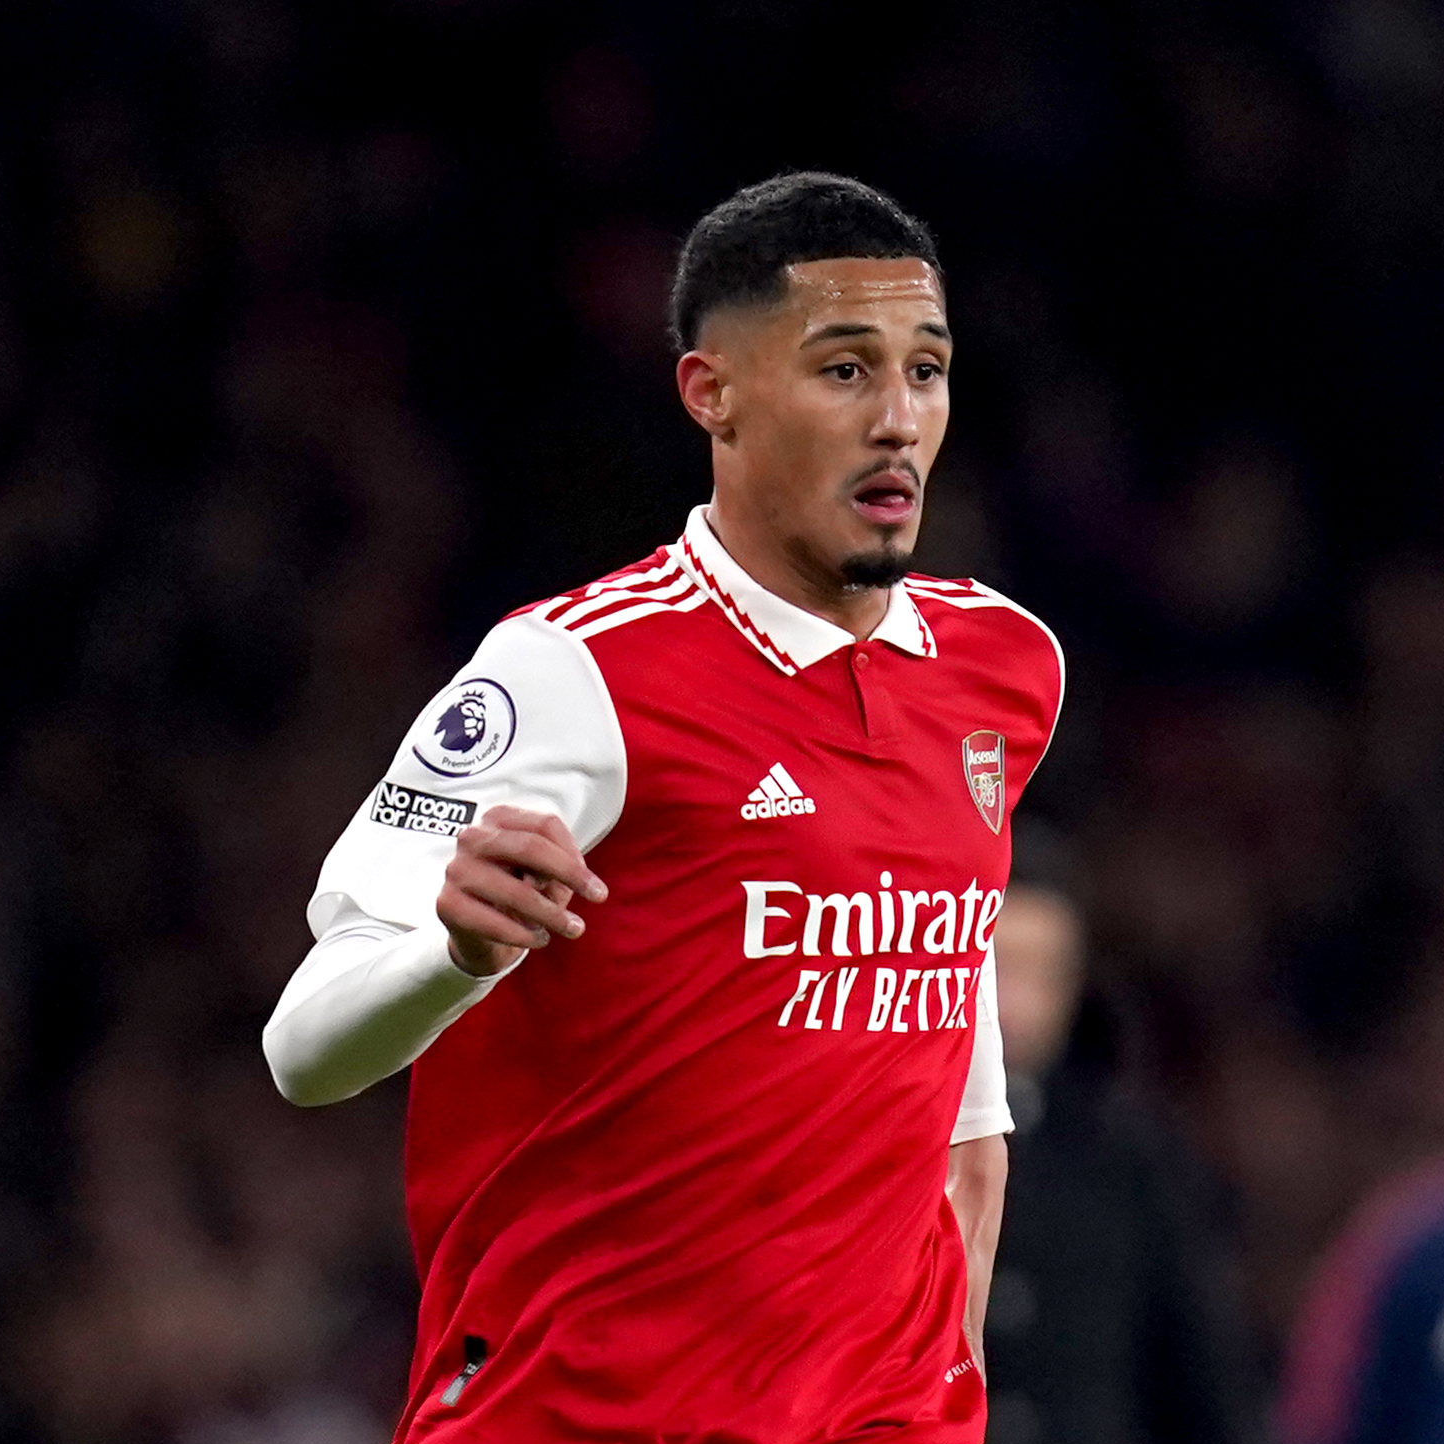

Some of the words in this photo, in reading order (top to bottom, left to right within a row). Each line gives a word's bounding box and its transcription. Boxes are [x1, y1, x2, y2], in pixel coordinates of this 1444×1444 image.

[442, 756, 476, 768] Premier
[476, 733, 500, 762] League
[969, 746, 998, 765] Arsenal
[372, 800, 406, 826] for
[376, 782, 411, 809] No
[412, 795, 467, 822] room
[740, 796, 816, 821] adidas
[741, 870, 1005, 959] Emirate
[777, 967, 860, 1031] FLY
